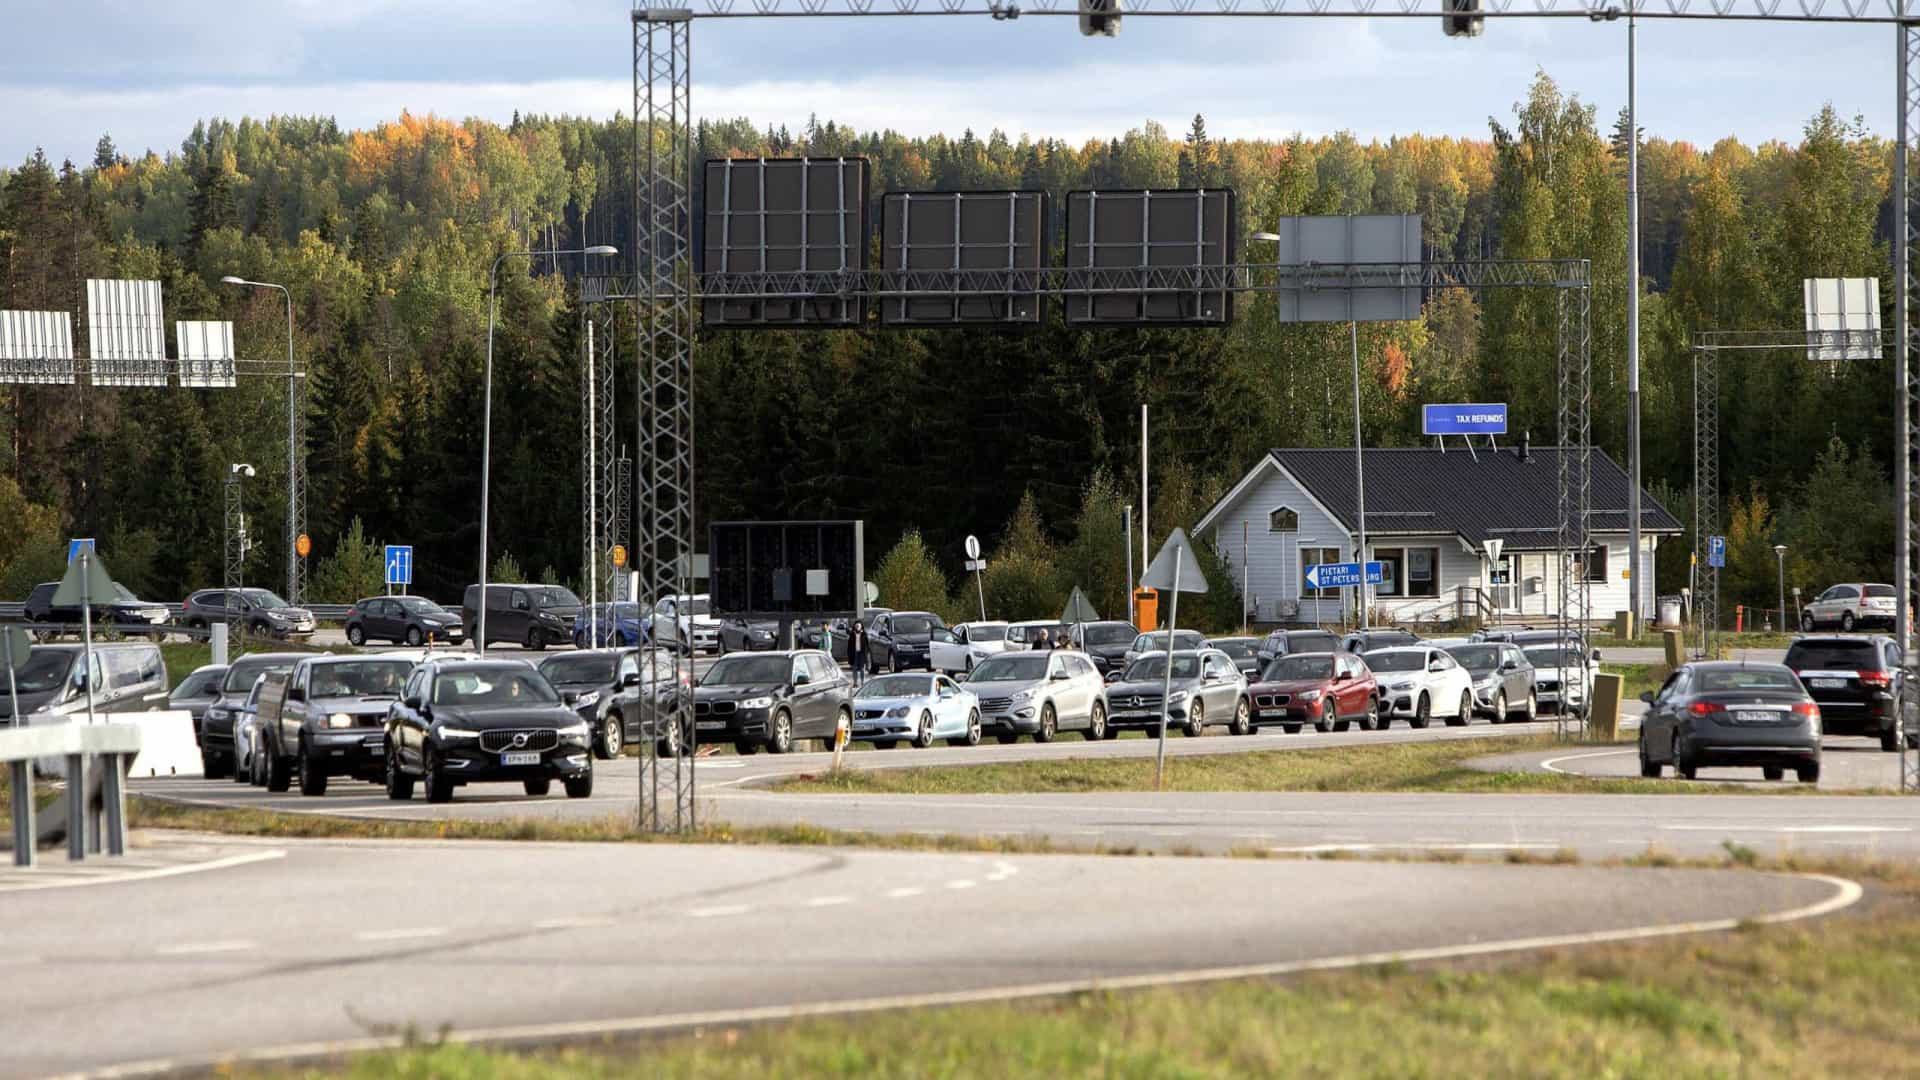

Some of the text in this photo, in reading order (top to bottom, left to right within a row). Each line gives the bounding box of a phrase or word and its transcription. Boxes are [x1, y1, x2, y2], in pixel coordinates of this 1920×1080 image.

[1456, 415, 1471, 424] TAX
[1472, 414, 1504, 423] REFUNDS
[1713, 538, 1723, 553] P
[1320, 566, 1349, 576] PIETARI
[1321, 575, 1330, 585] ST
